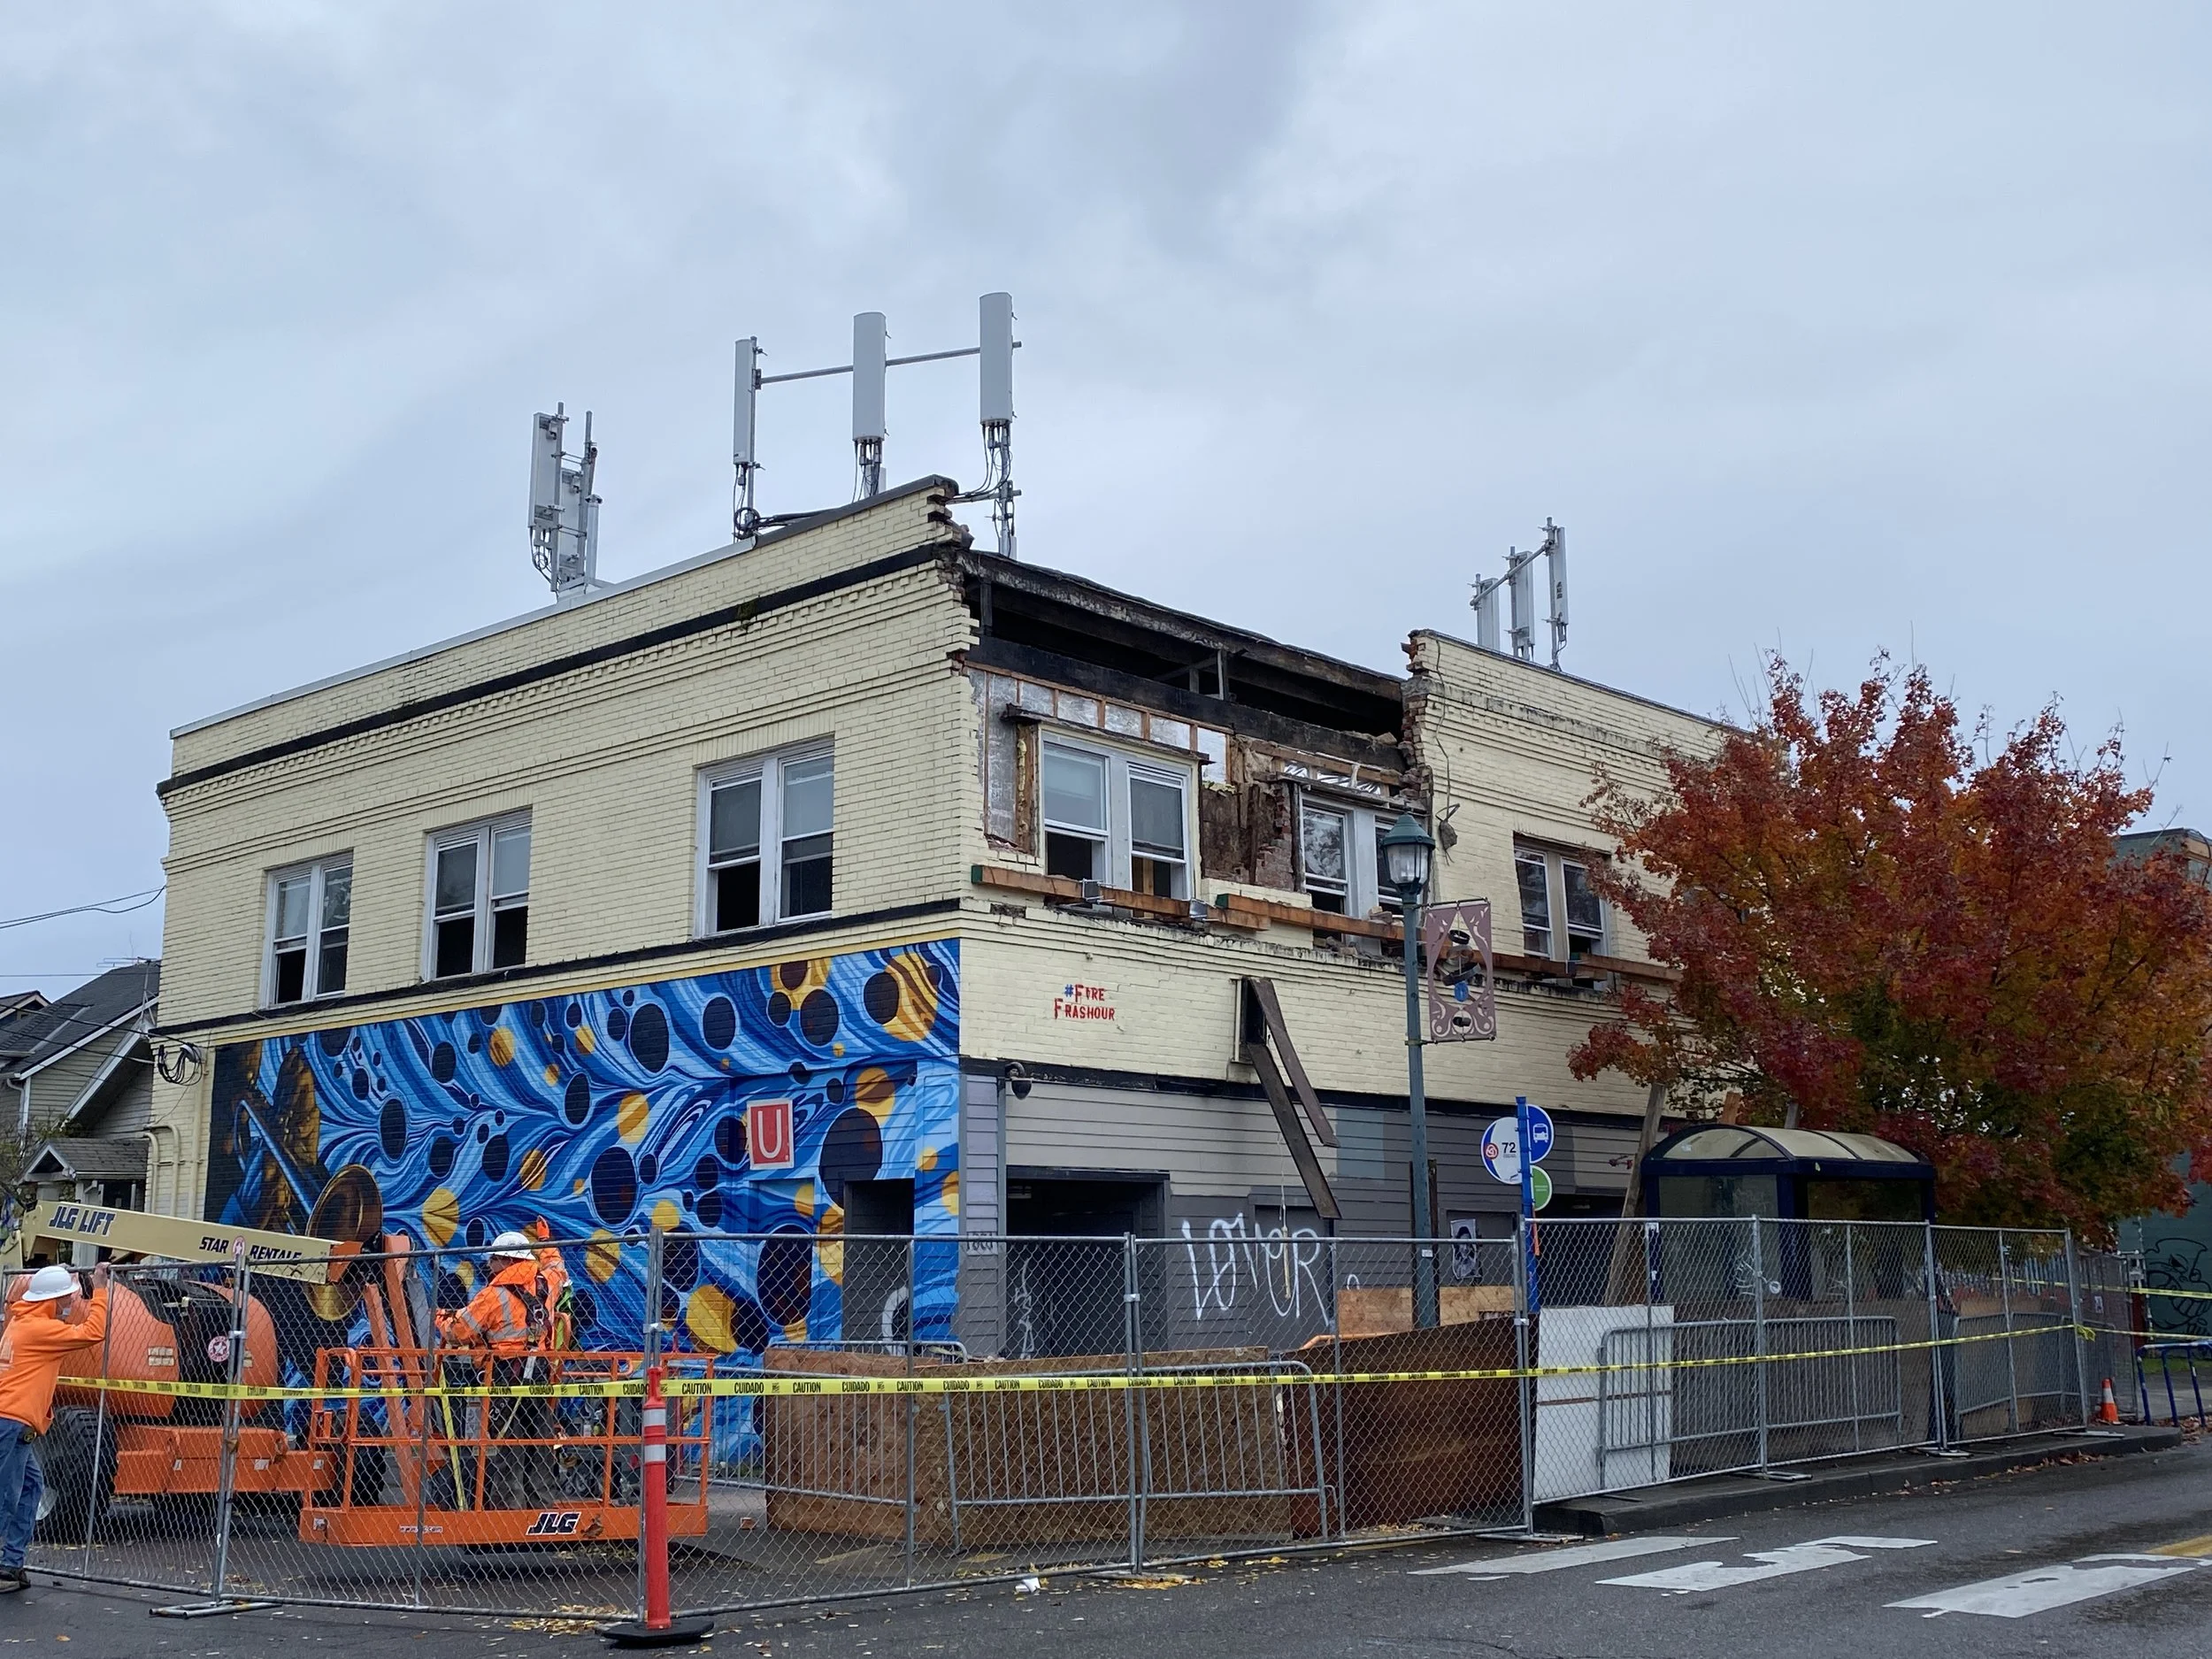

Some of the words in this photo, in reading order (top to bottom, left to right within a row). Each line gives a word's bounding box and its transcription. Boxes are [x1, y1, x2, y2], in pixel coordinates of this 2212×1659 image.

[1054, 997, 1115, 1020] FRASHOUR
[757, 1109, 781, 1158] U
[1502, 1141, 1517, 1154] 72
[49, 1205, 80, 1231] JLG
[77, 1210, 116, 1237] LIFT
[199, 1236, 229, 1254] STAR
[579, 1384, 604, 1395] CAUTION
[681, 1382, 711, 1394] CAUTION
[734, 1382, 764, 1394] CUIDADO
[793, 1381, 821, 1394] CAUTION
[841, 1380, 871, 1392] CUIDADO
[896, 1380, 924, 1391] CAUTION
[942, 1379, 970, 1391] CUIDADO
[995, 1379, 1020, 1390] CAUTION
[526, 1512, 581, 1535] JLG
